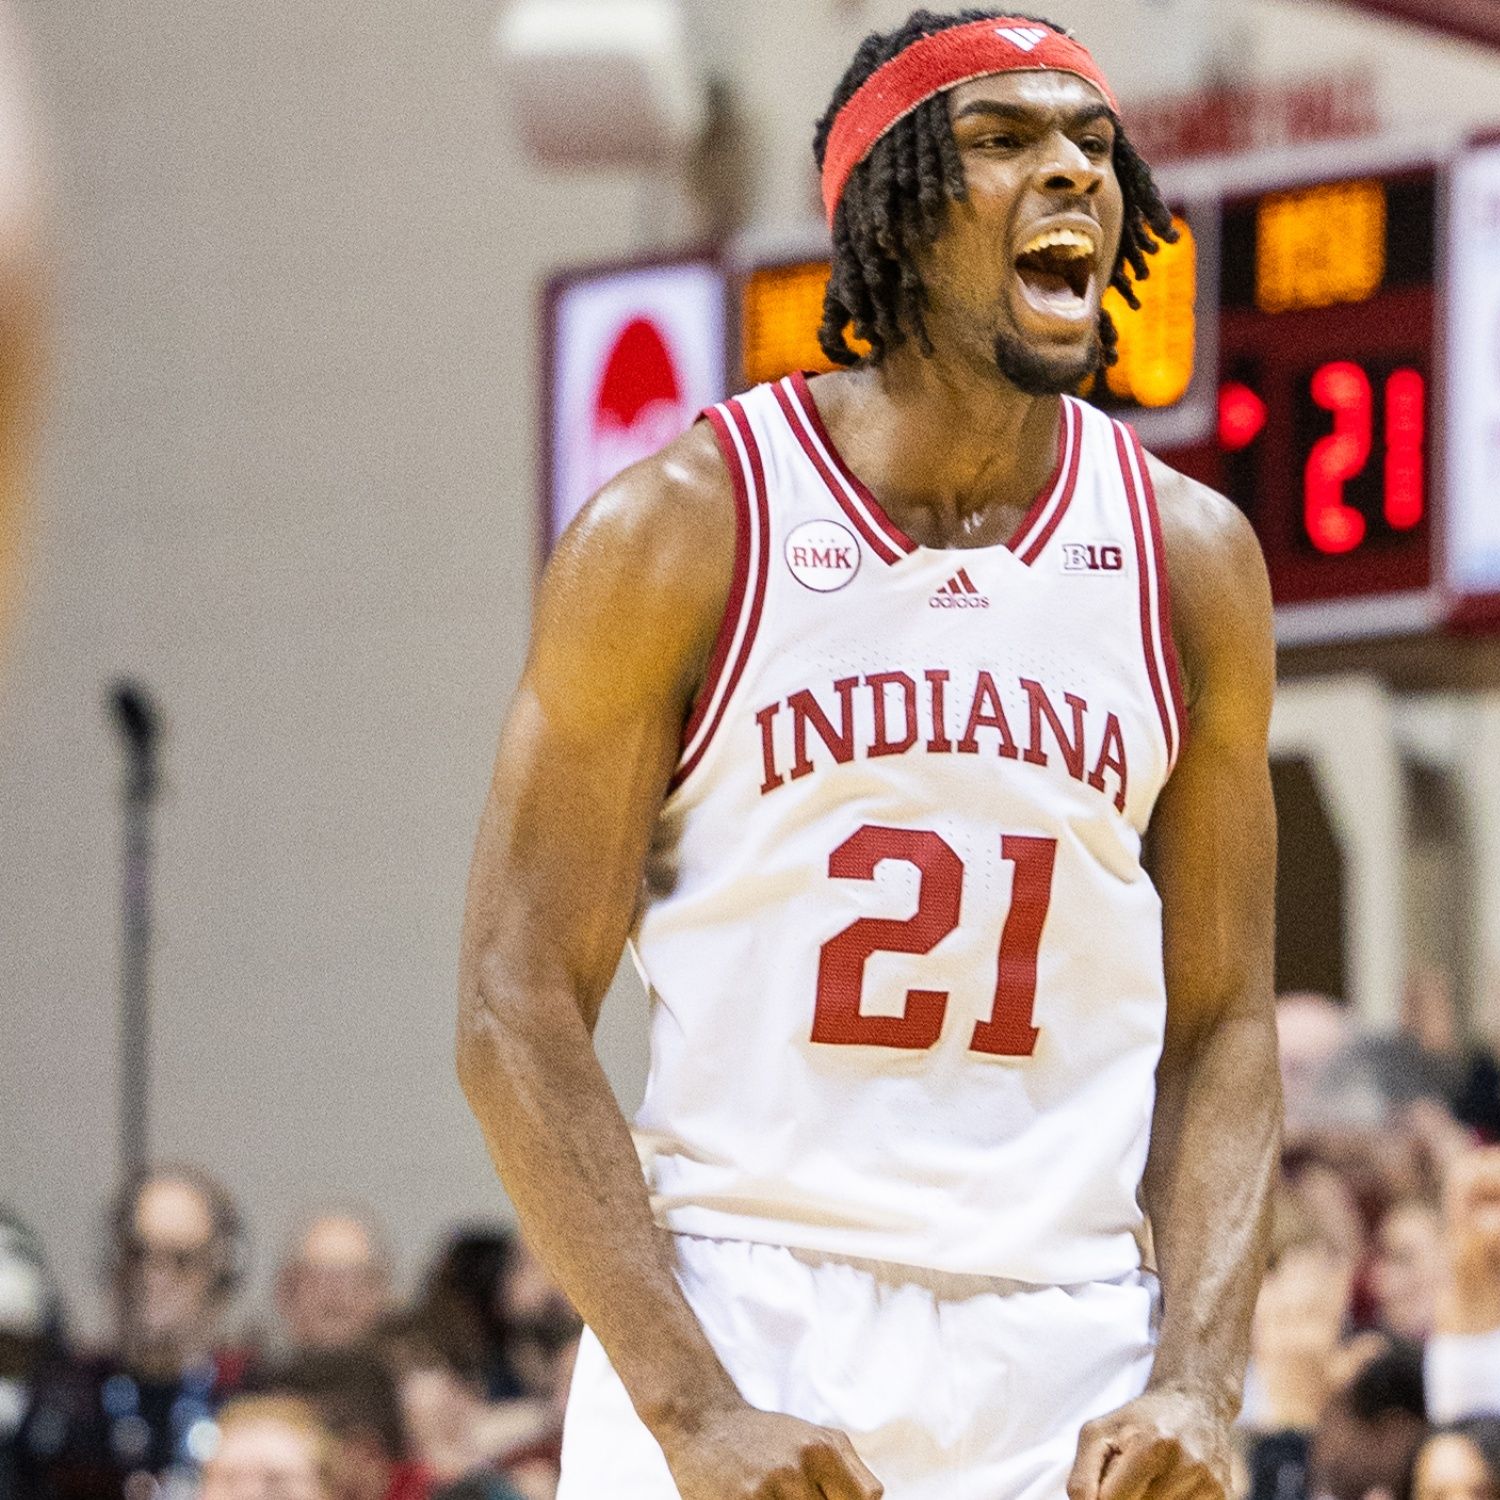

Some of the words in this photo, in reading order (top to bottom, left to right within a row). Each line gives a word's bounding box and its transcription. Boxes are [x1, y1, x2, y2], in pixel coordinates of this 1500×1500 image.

[1304, 360, 1425, 554] 21
[793, 546, 852, 569] RMK
[929, 596, 989, 609] adidas
[755, 669, 1128, 814] INDIANA
[810, 824, 1058, 1056] 21
